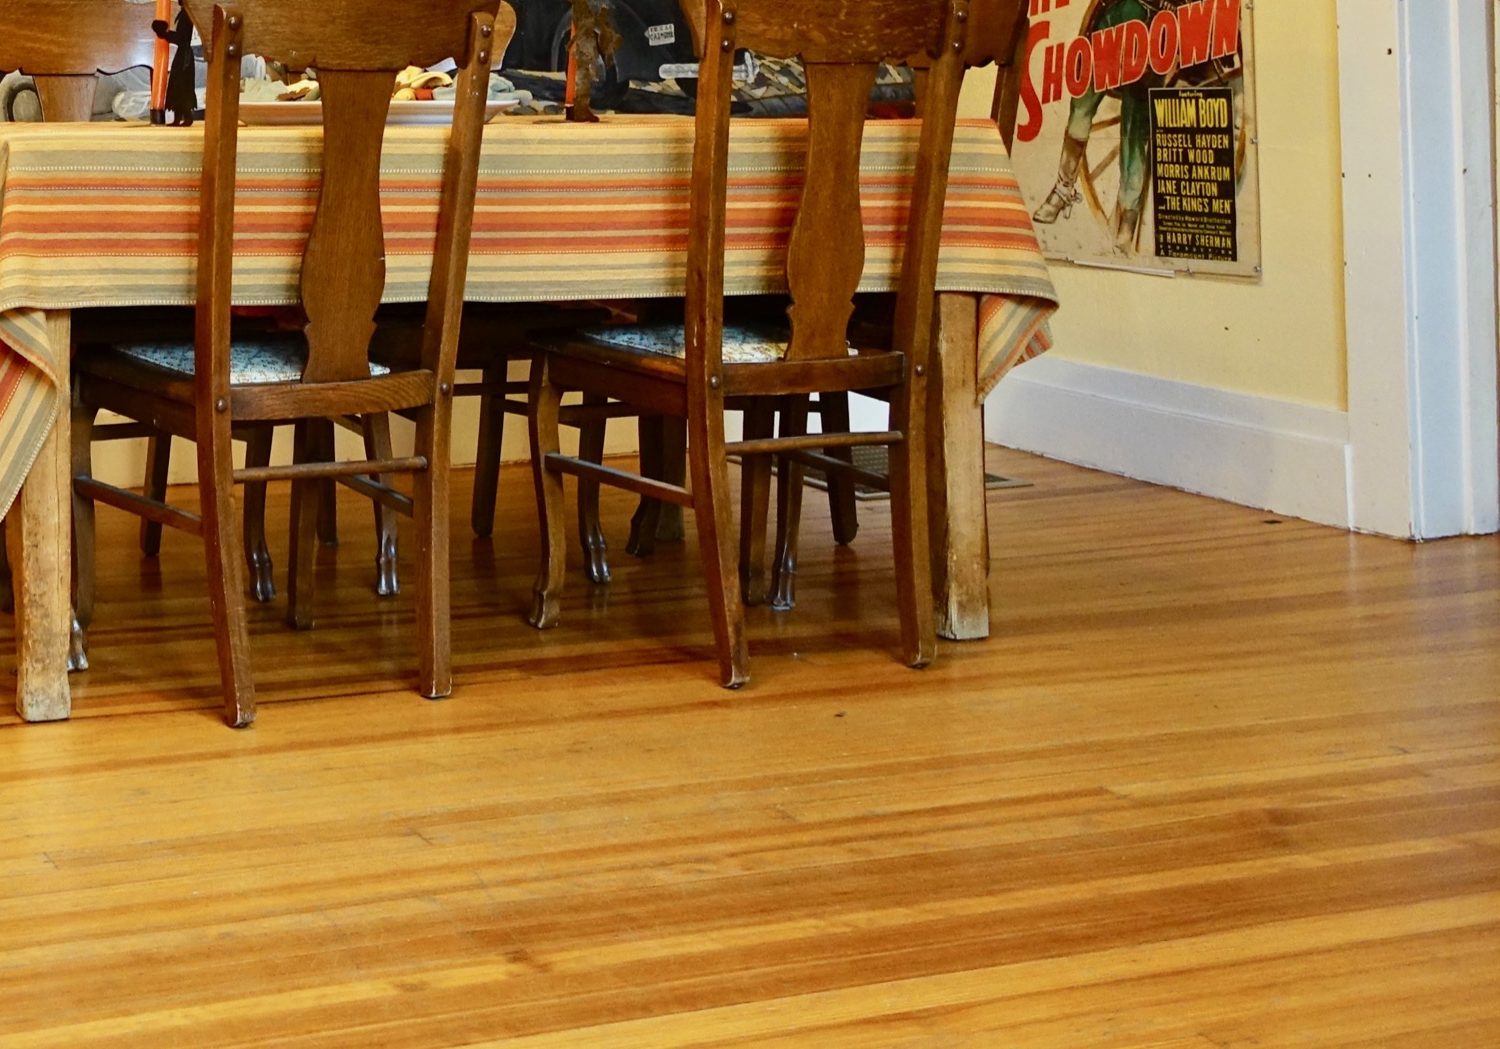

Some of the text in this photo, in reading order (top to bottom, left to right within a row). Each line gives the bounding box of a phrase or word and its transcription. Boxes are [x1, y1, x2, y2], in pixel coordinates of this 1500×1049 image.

[1154, 98, 1228, 128] WILLIAM BOYD
[1156, 133, 1229, 149] RUSSELL HAYDEN
[1156, 147, 1214, 164] BRITT WOOD
[1156, 163, 1230, 181] MORRIS ANKRUM
[1157, 179, 1218, 197] JANE CLAYTON
[1166, 232, 1192, 245] HARRY
[1195, 234, 1232, 249] SHERMAN
